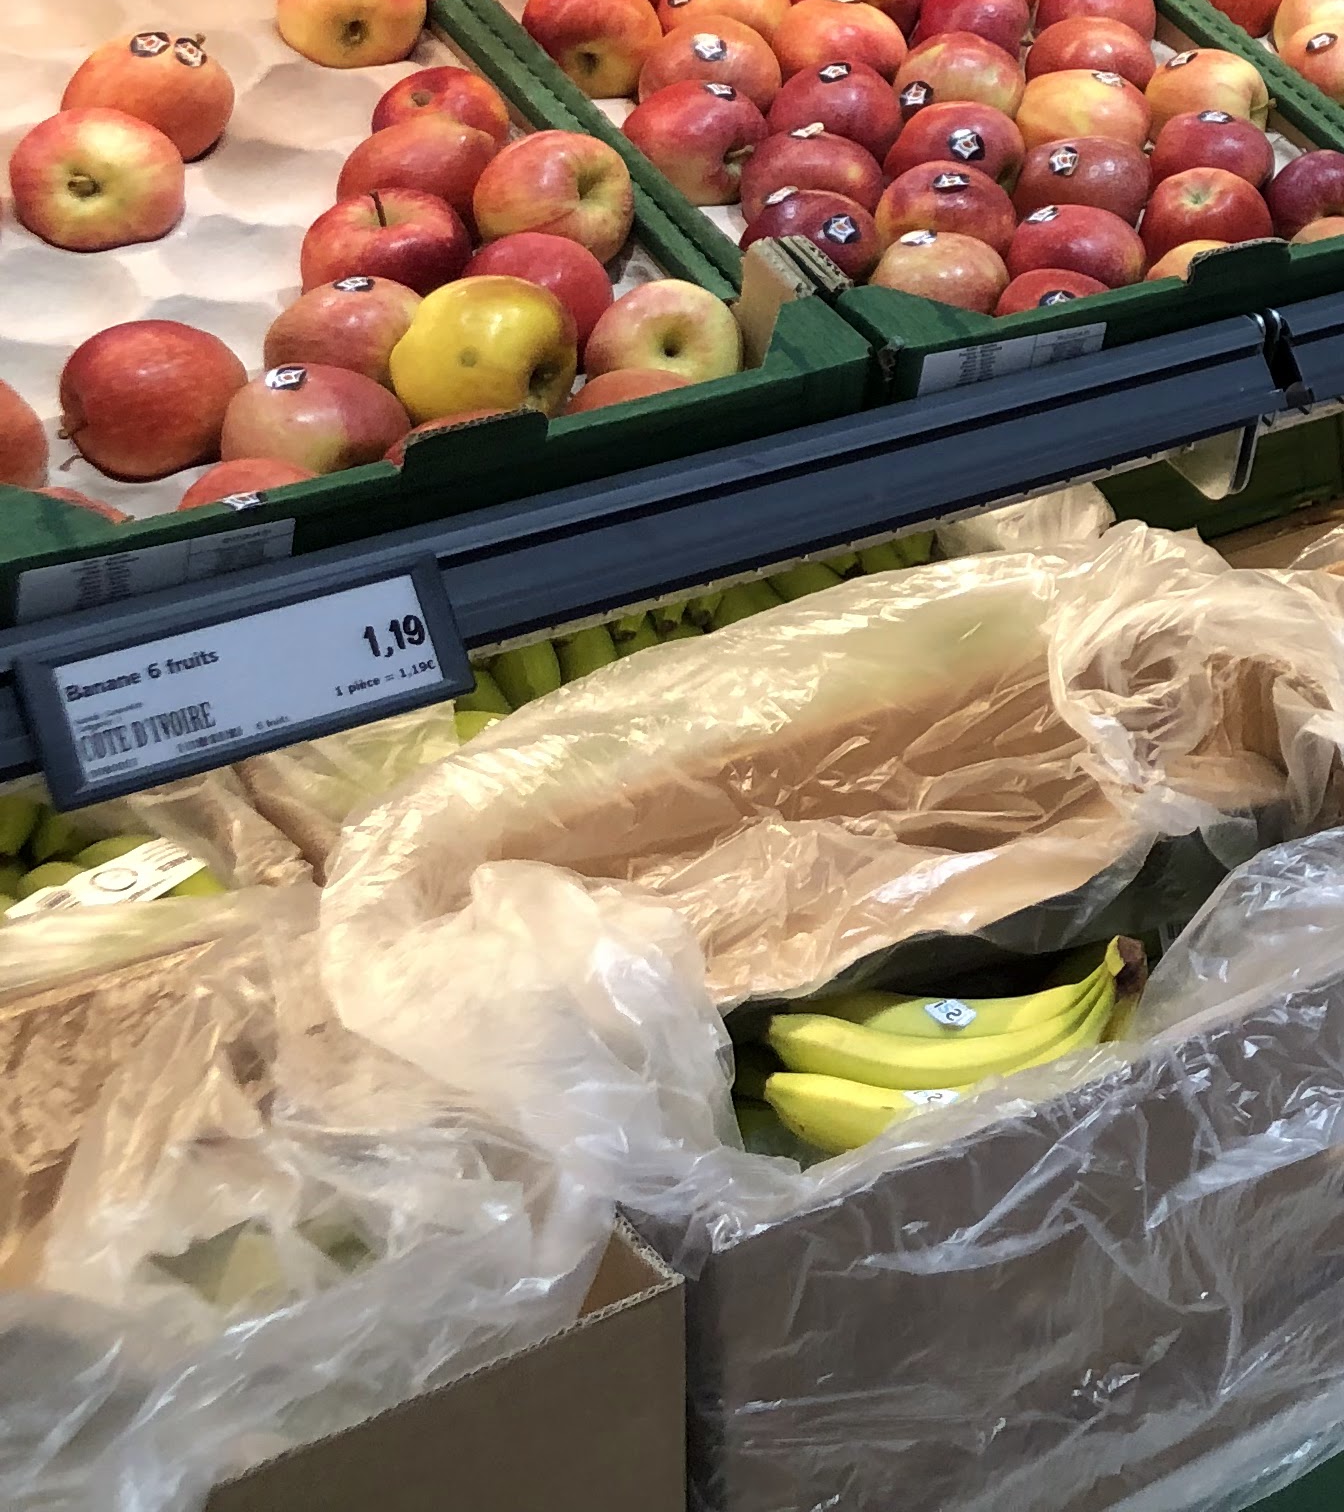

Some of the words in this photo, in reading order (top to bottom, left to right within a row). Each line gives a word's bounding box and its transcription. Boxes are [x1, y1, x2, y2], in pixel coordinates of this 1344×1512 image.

[363, 614, 426, 659] 1,19
[65, 671, 142, 704] Banane
[148, 662, 162, 680] 6
[166, 648, 220, 676] fruits
[335, 684, 343, 697] 1
[347, 675, 381, 696] pièce
[133, 701, 217, 749] D'IVOIRE
